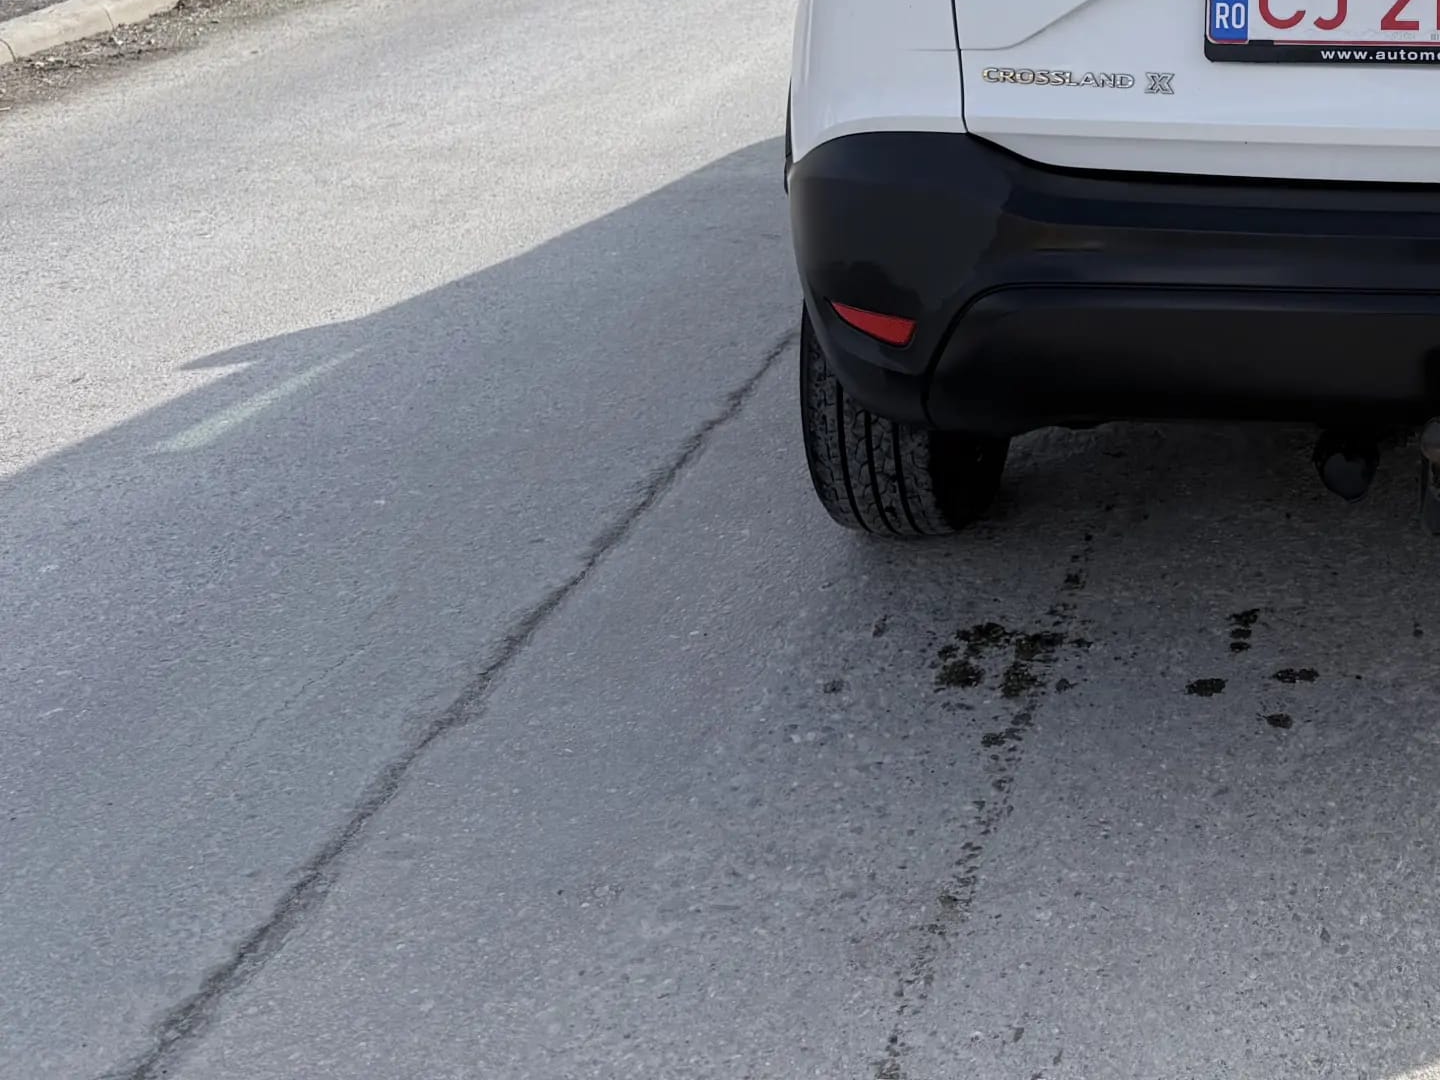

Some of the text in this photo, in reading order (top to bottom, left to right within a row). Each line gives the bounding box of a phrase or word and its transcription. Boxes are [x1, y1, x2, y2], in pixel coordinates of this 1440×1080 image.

[1215, 2, 1246, 29] RO
[982, 67, 1175, 95] CROSSLAND X
